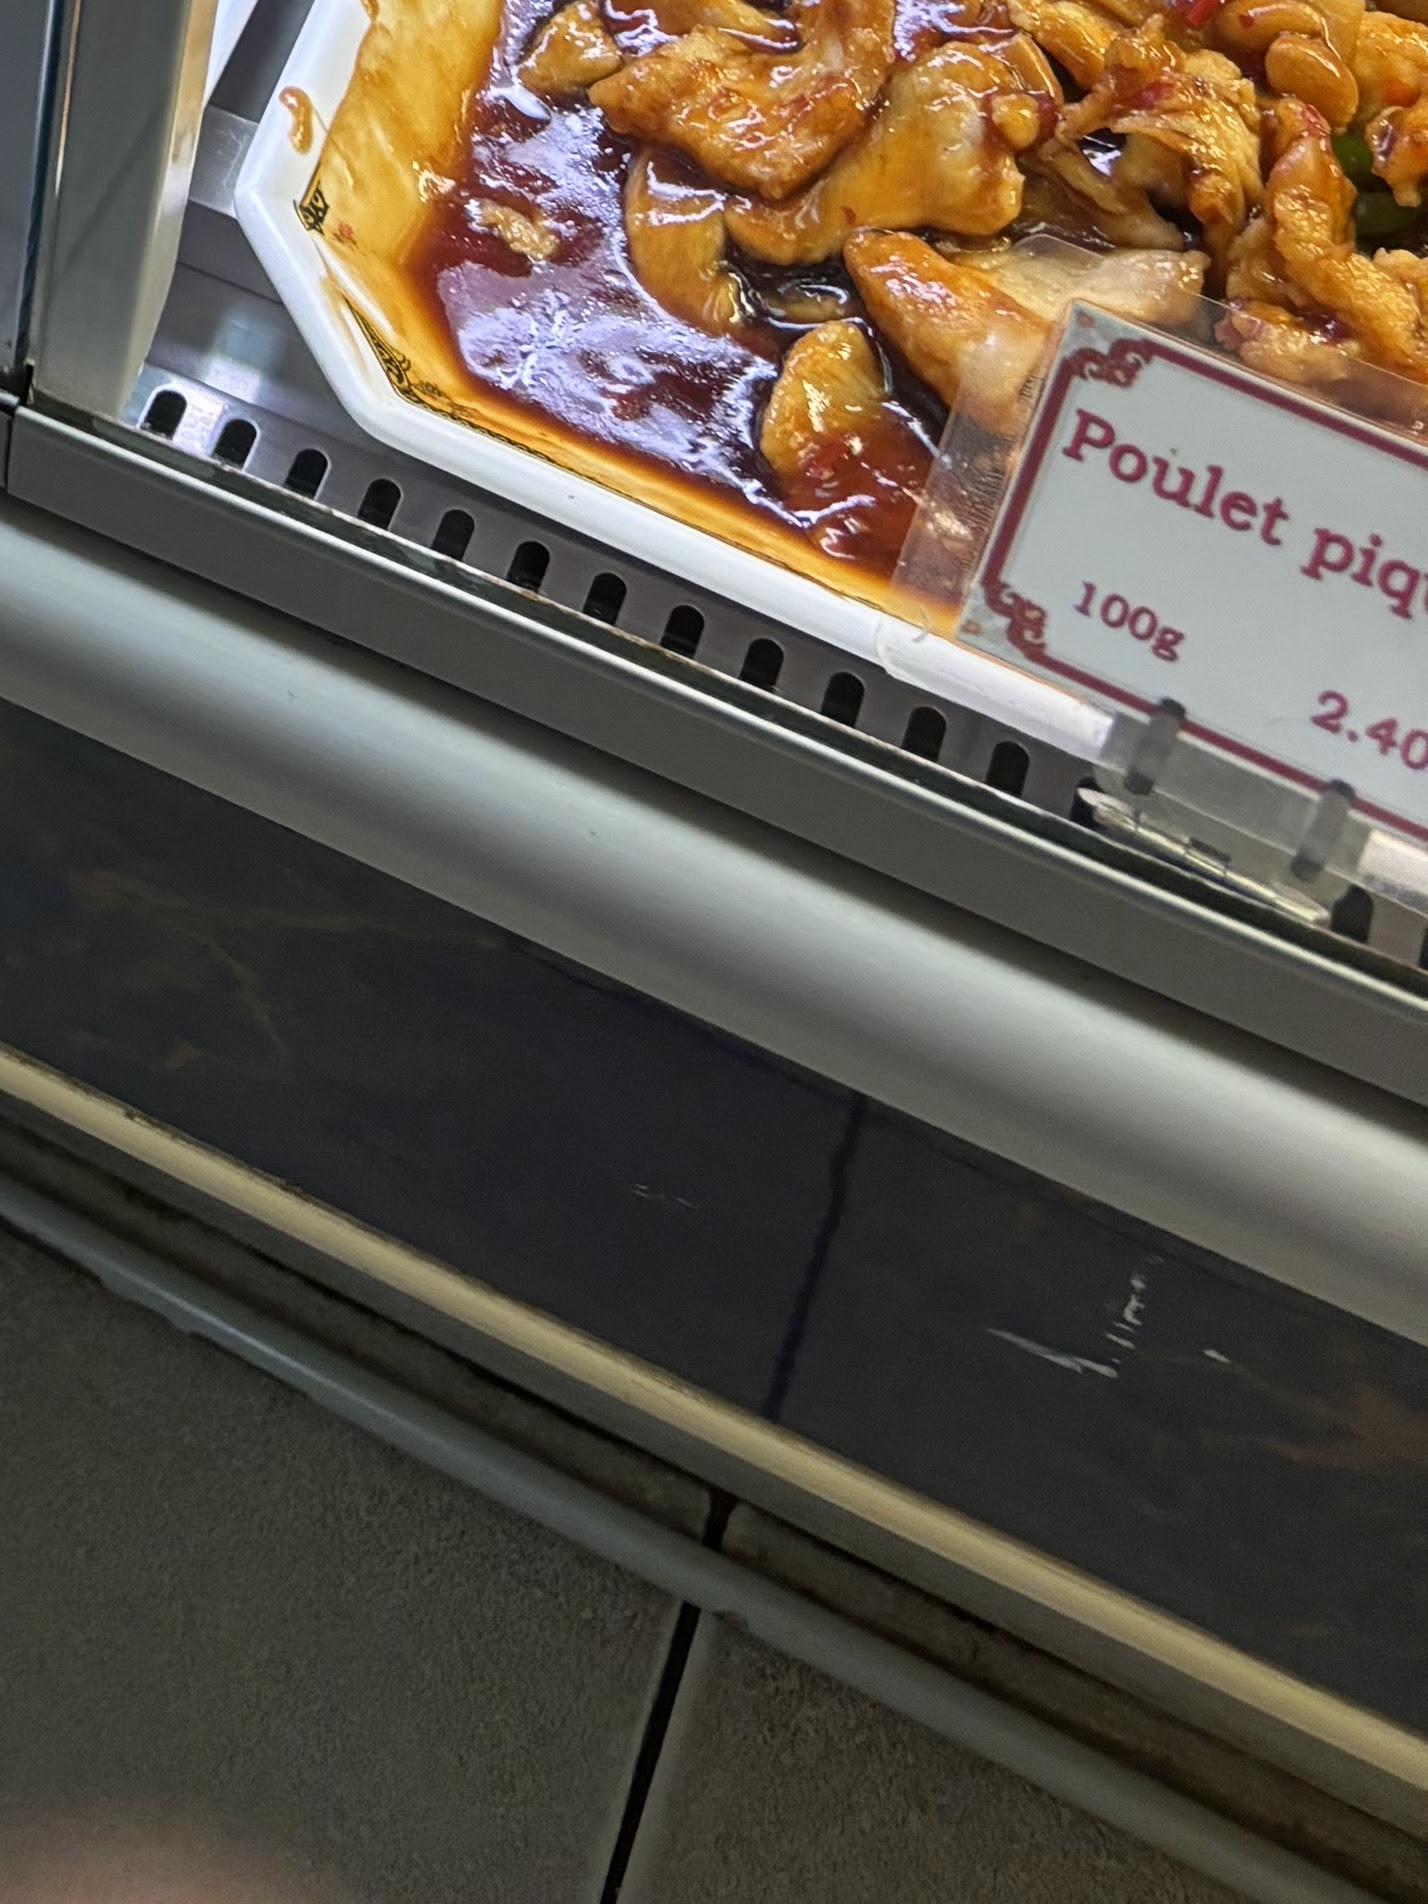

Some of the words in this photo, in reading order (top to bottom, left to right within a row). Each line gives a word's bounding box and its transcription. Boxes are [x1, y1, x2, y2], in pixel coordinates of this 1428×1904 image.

[1063, 408, 1291, 547] Poulet
[1300, 525, 1428, 622] piq
[1072, 581, 1187, 663] 100g
[1310, 690, 1428, 772] 2.40
